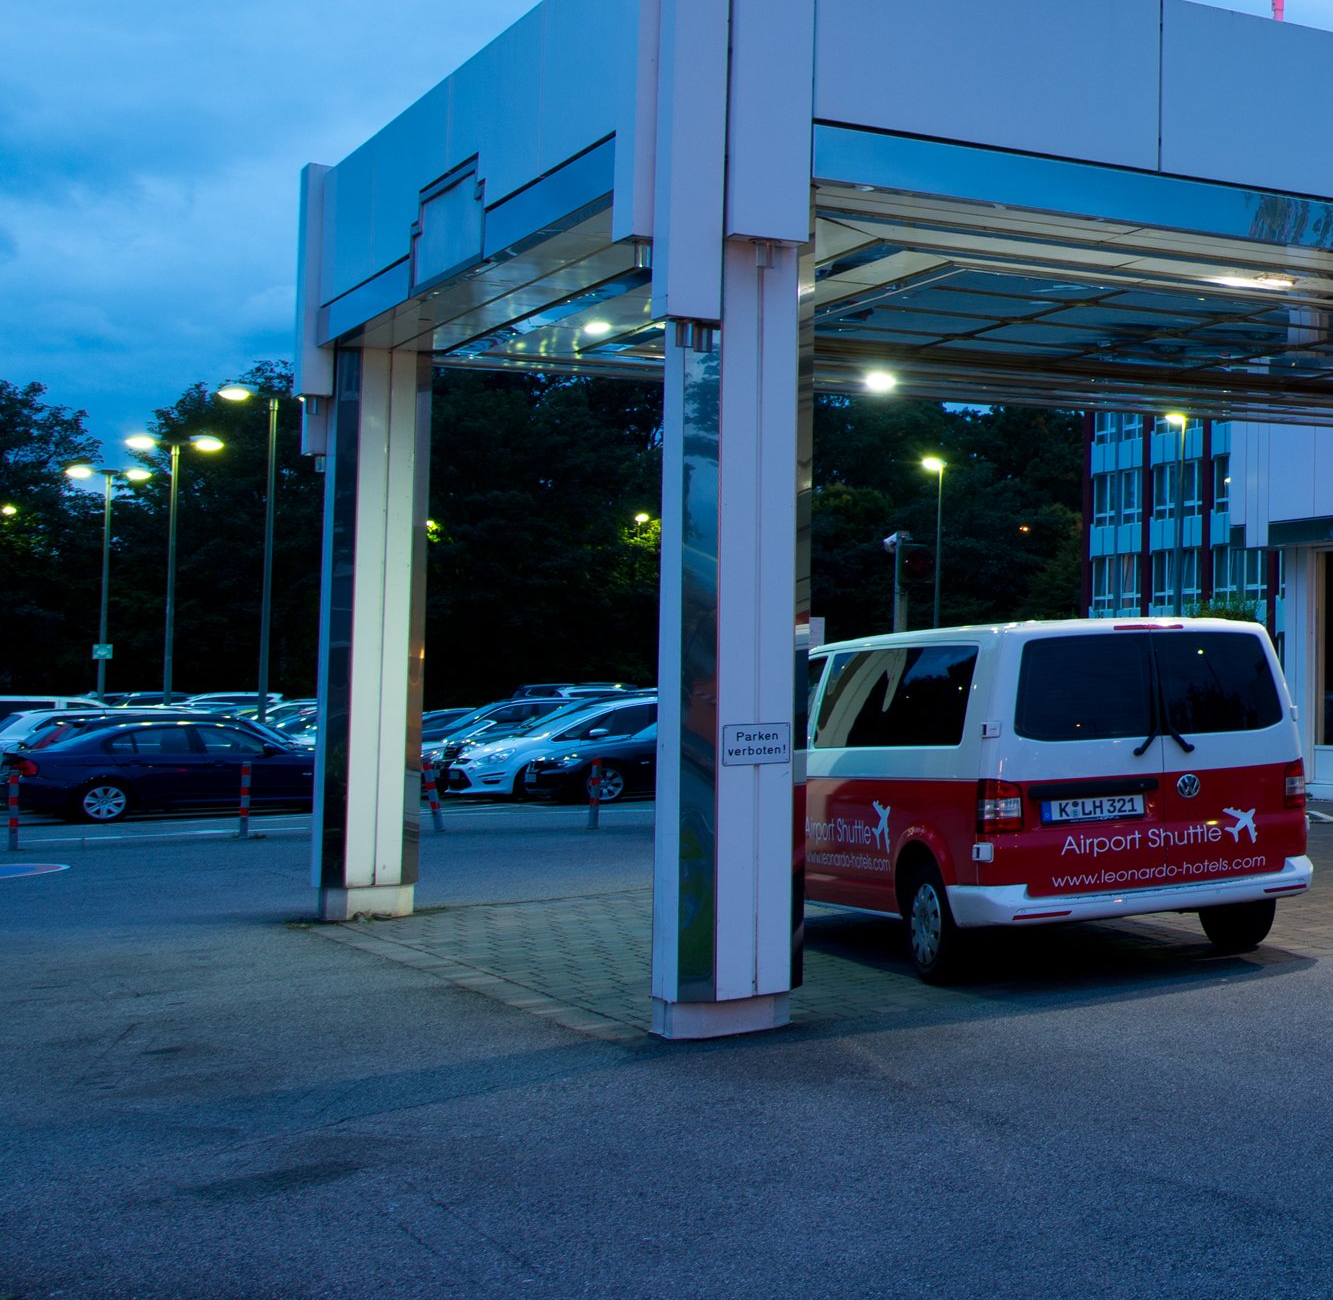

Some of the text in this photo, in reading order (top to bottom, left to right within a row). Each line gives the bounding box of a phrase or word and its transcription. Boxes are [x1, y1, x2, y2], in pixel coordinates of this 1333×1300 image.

[736, 731, 779, 741] Parken
[728, 744, 786, 756] verboten!
[1059, 798, 1137, 817] K LH 321
[806, 816, 871, 845] Airport Shuttle
[1061, 825, 1222, 857] Airport Shuttle
[1052, 855, 1266, 887] www.leonardo-hotels.com
